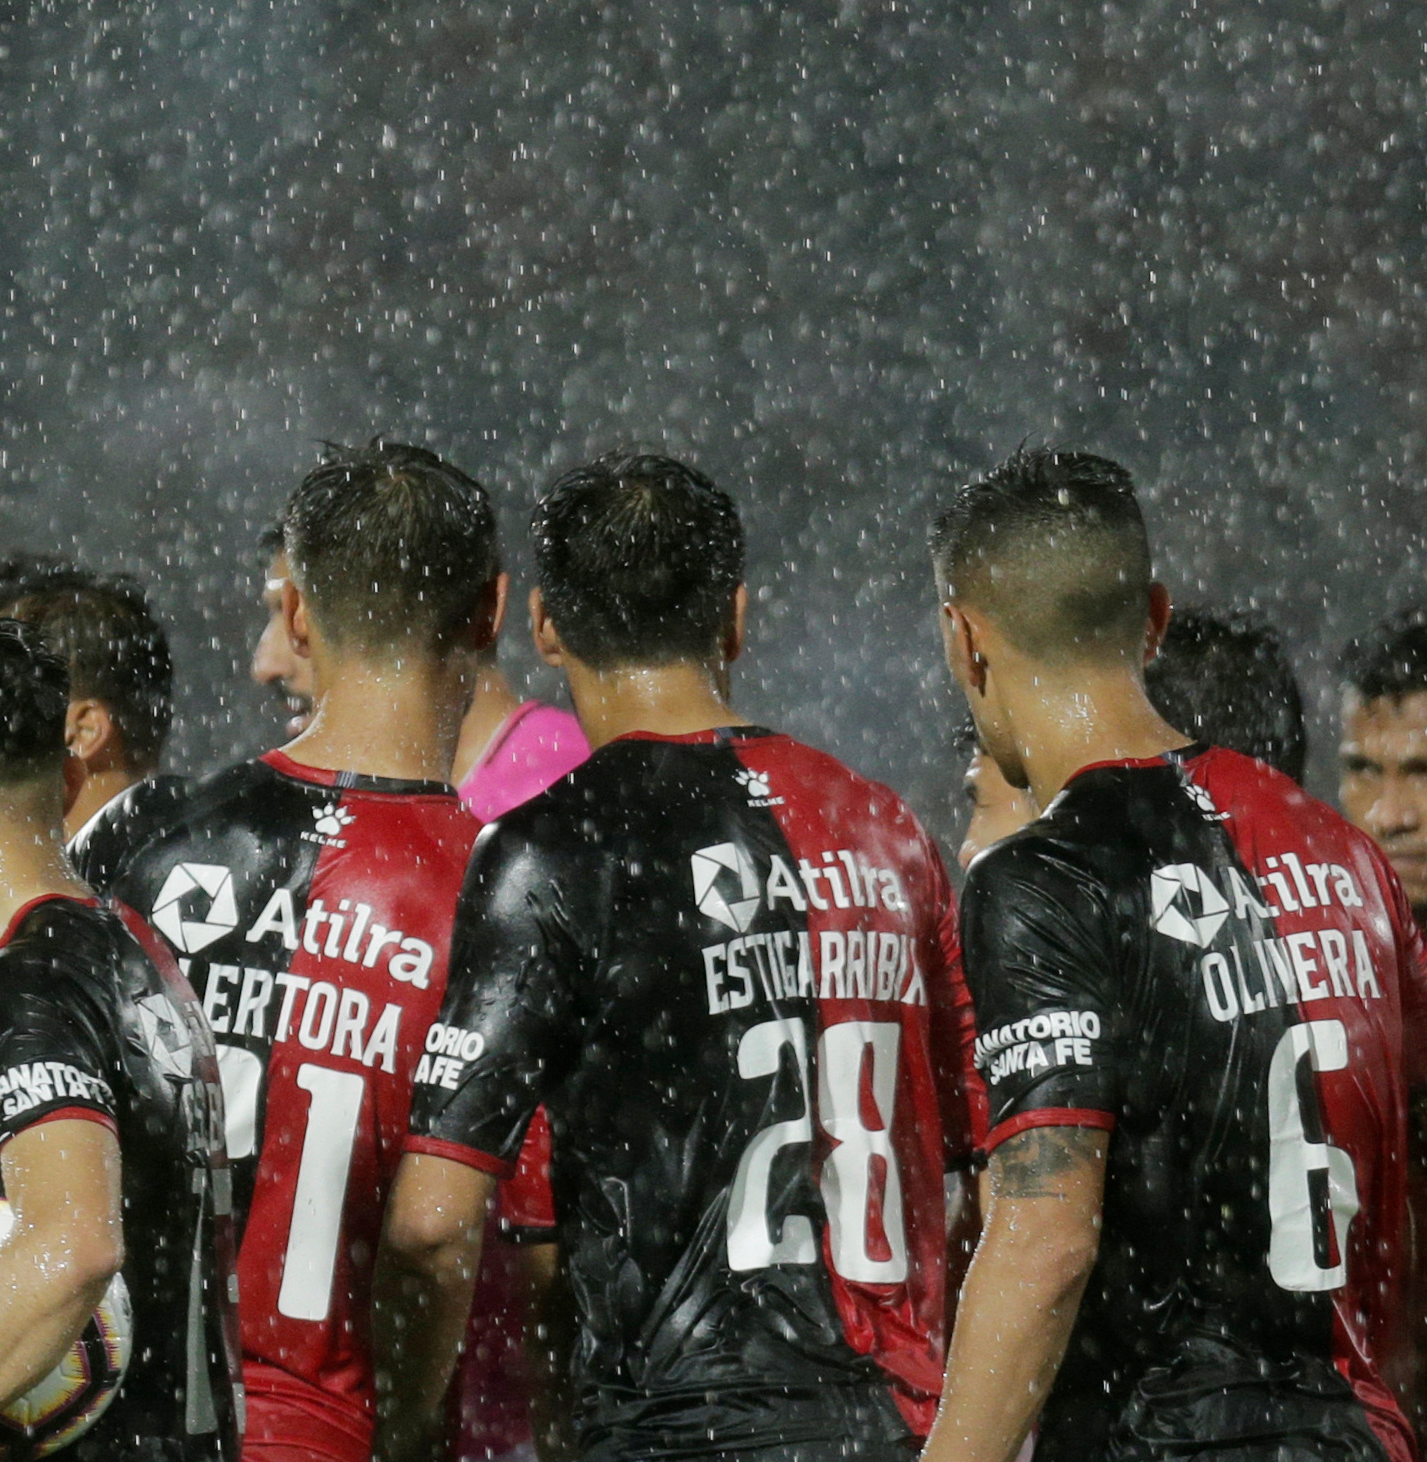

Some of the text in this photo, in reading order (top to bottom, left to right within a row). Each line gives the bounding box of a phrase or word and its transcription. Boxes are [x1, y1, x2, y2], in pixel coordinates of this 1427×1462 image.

[300, 831, 347, 849] KELME
[767, 850, 904, 914] Atilra
[245, 888, 436, 990] Atilra
[1202, 929, 1382, 1023] OLIVERA
[177, 957, 403, 1075] ERTORA
[990, 1037, 1093, 1086] SANTA FE
[727, 1017, 908, 1284] 28
[1268, 1020, 1358, 1292] 6
